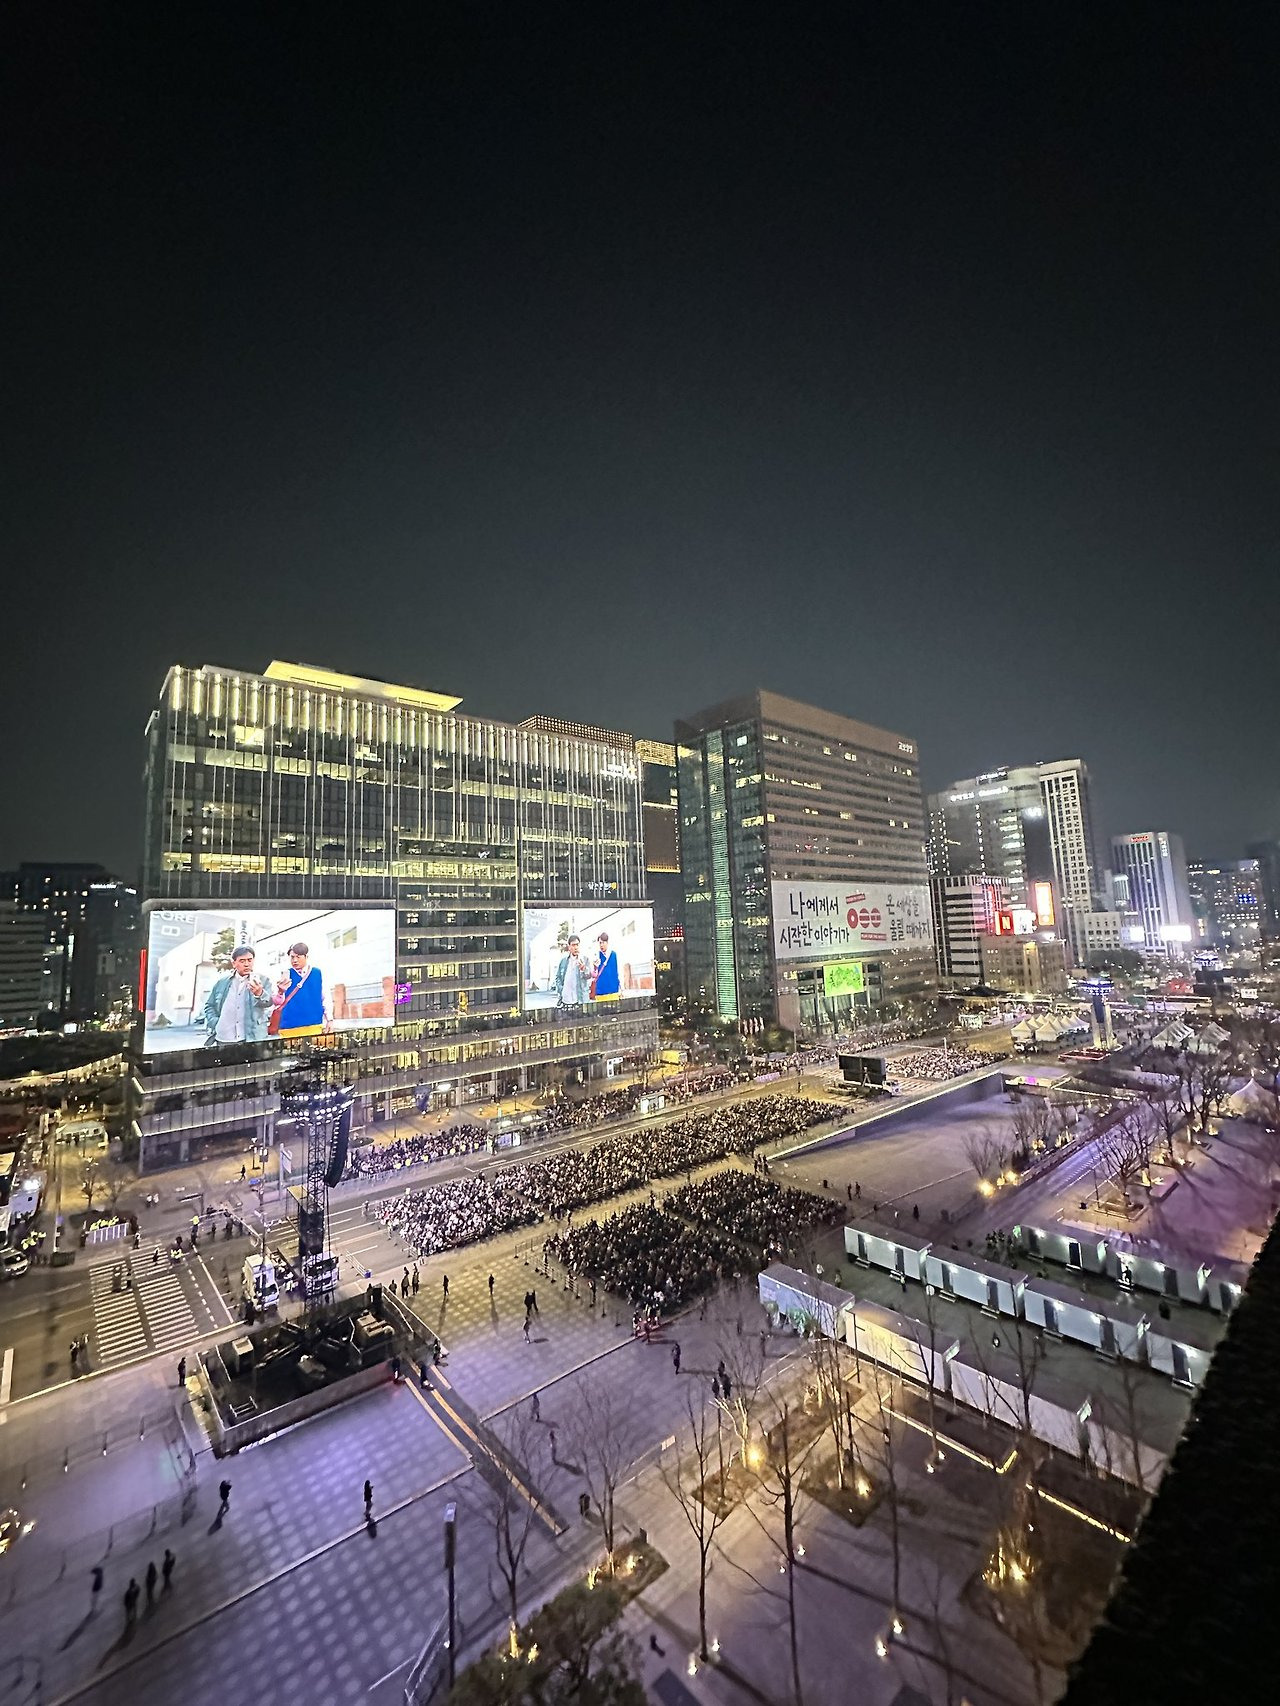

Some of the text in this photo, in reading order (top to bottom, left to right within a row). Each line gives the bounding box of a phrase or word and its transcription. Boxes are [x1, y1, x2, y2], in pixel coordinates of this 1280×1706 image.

[790, 891, 839, 919] 나에게서
[885, 893, 895, 915] 온
[896, 895, 920, 917] 세상을
[780, 921, 850, 949] 시작한 이야기가
[890, 918, 905, 941] 울릴
[906, 918, 931, 939] 때까지
